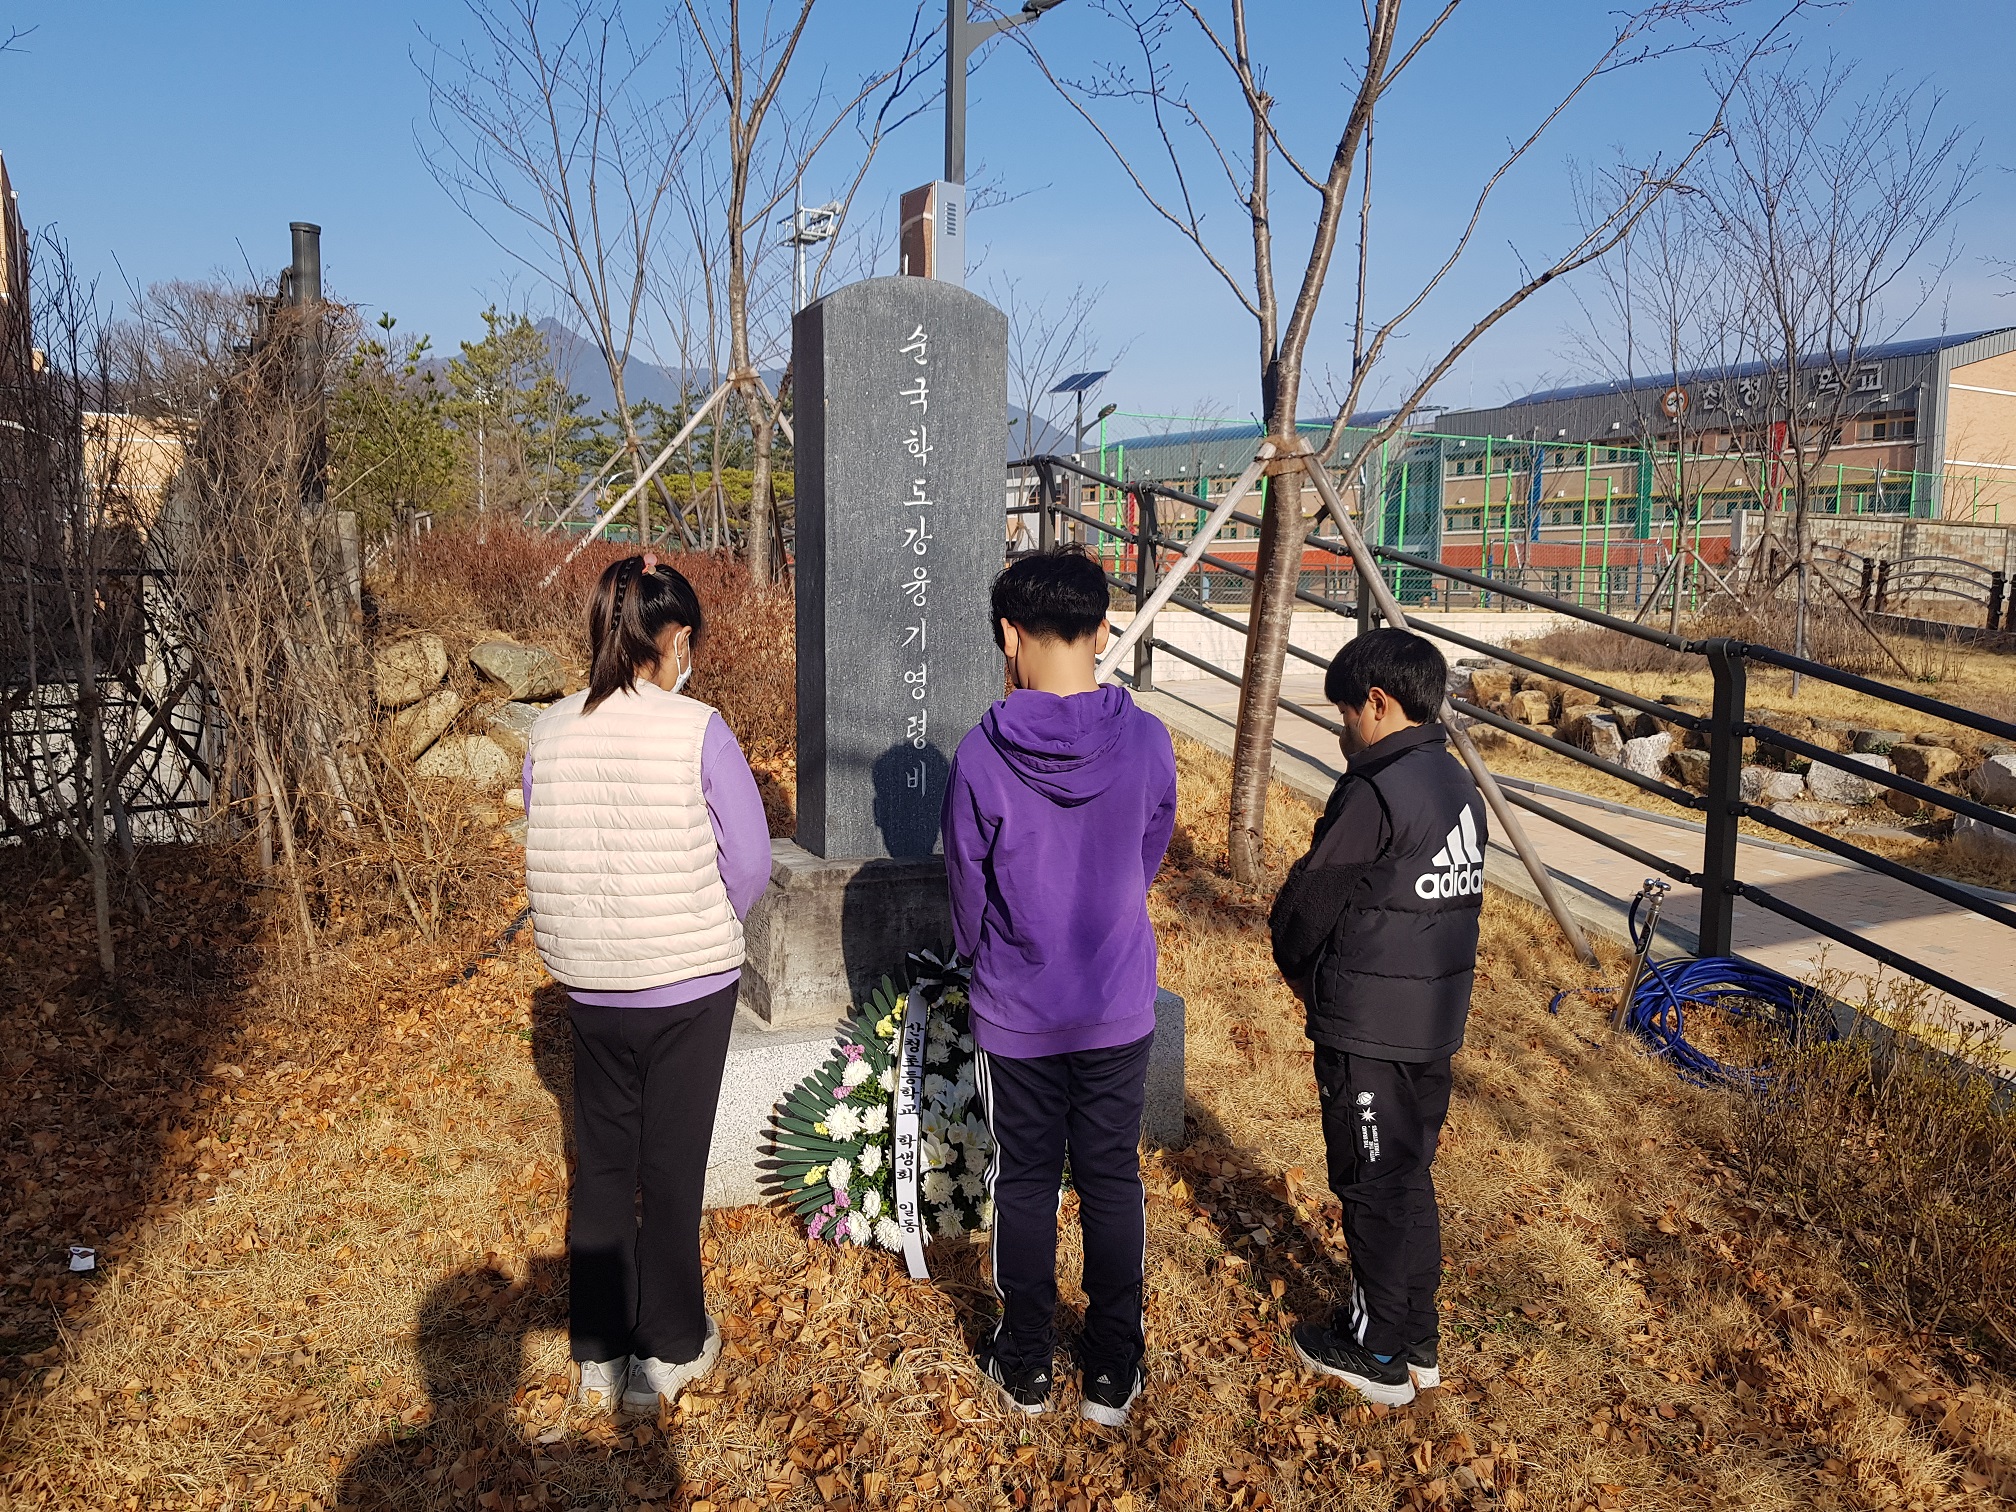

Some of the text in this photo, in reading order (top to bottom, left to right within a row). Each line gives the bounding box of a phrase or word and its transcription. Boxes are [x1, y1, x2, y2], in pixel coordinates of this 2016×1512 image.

[896, 1022, 924, 1233] 산청초등학교 학생회 일동
